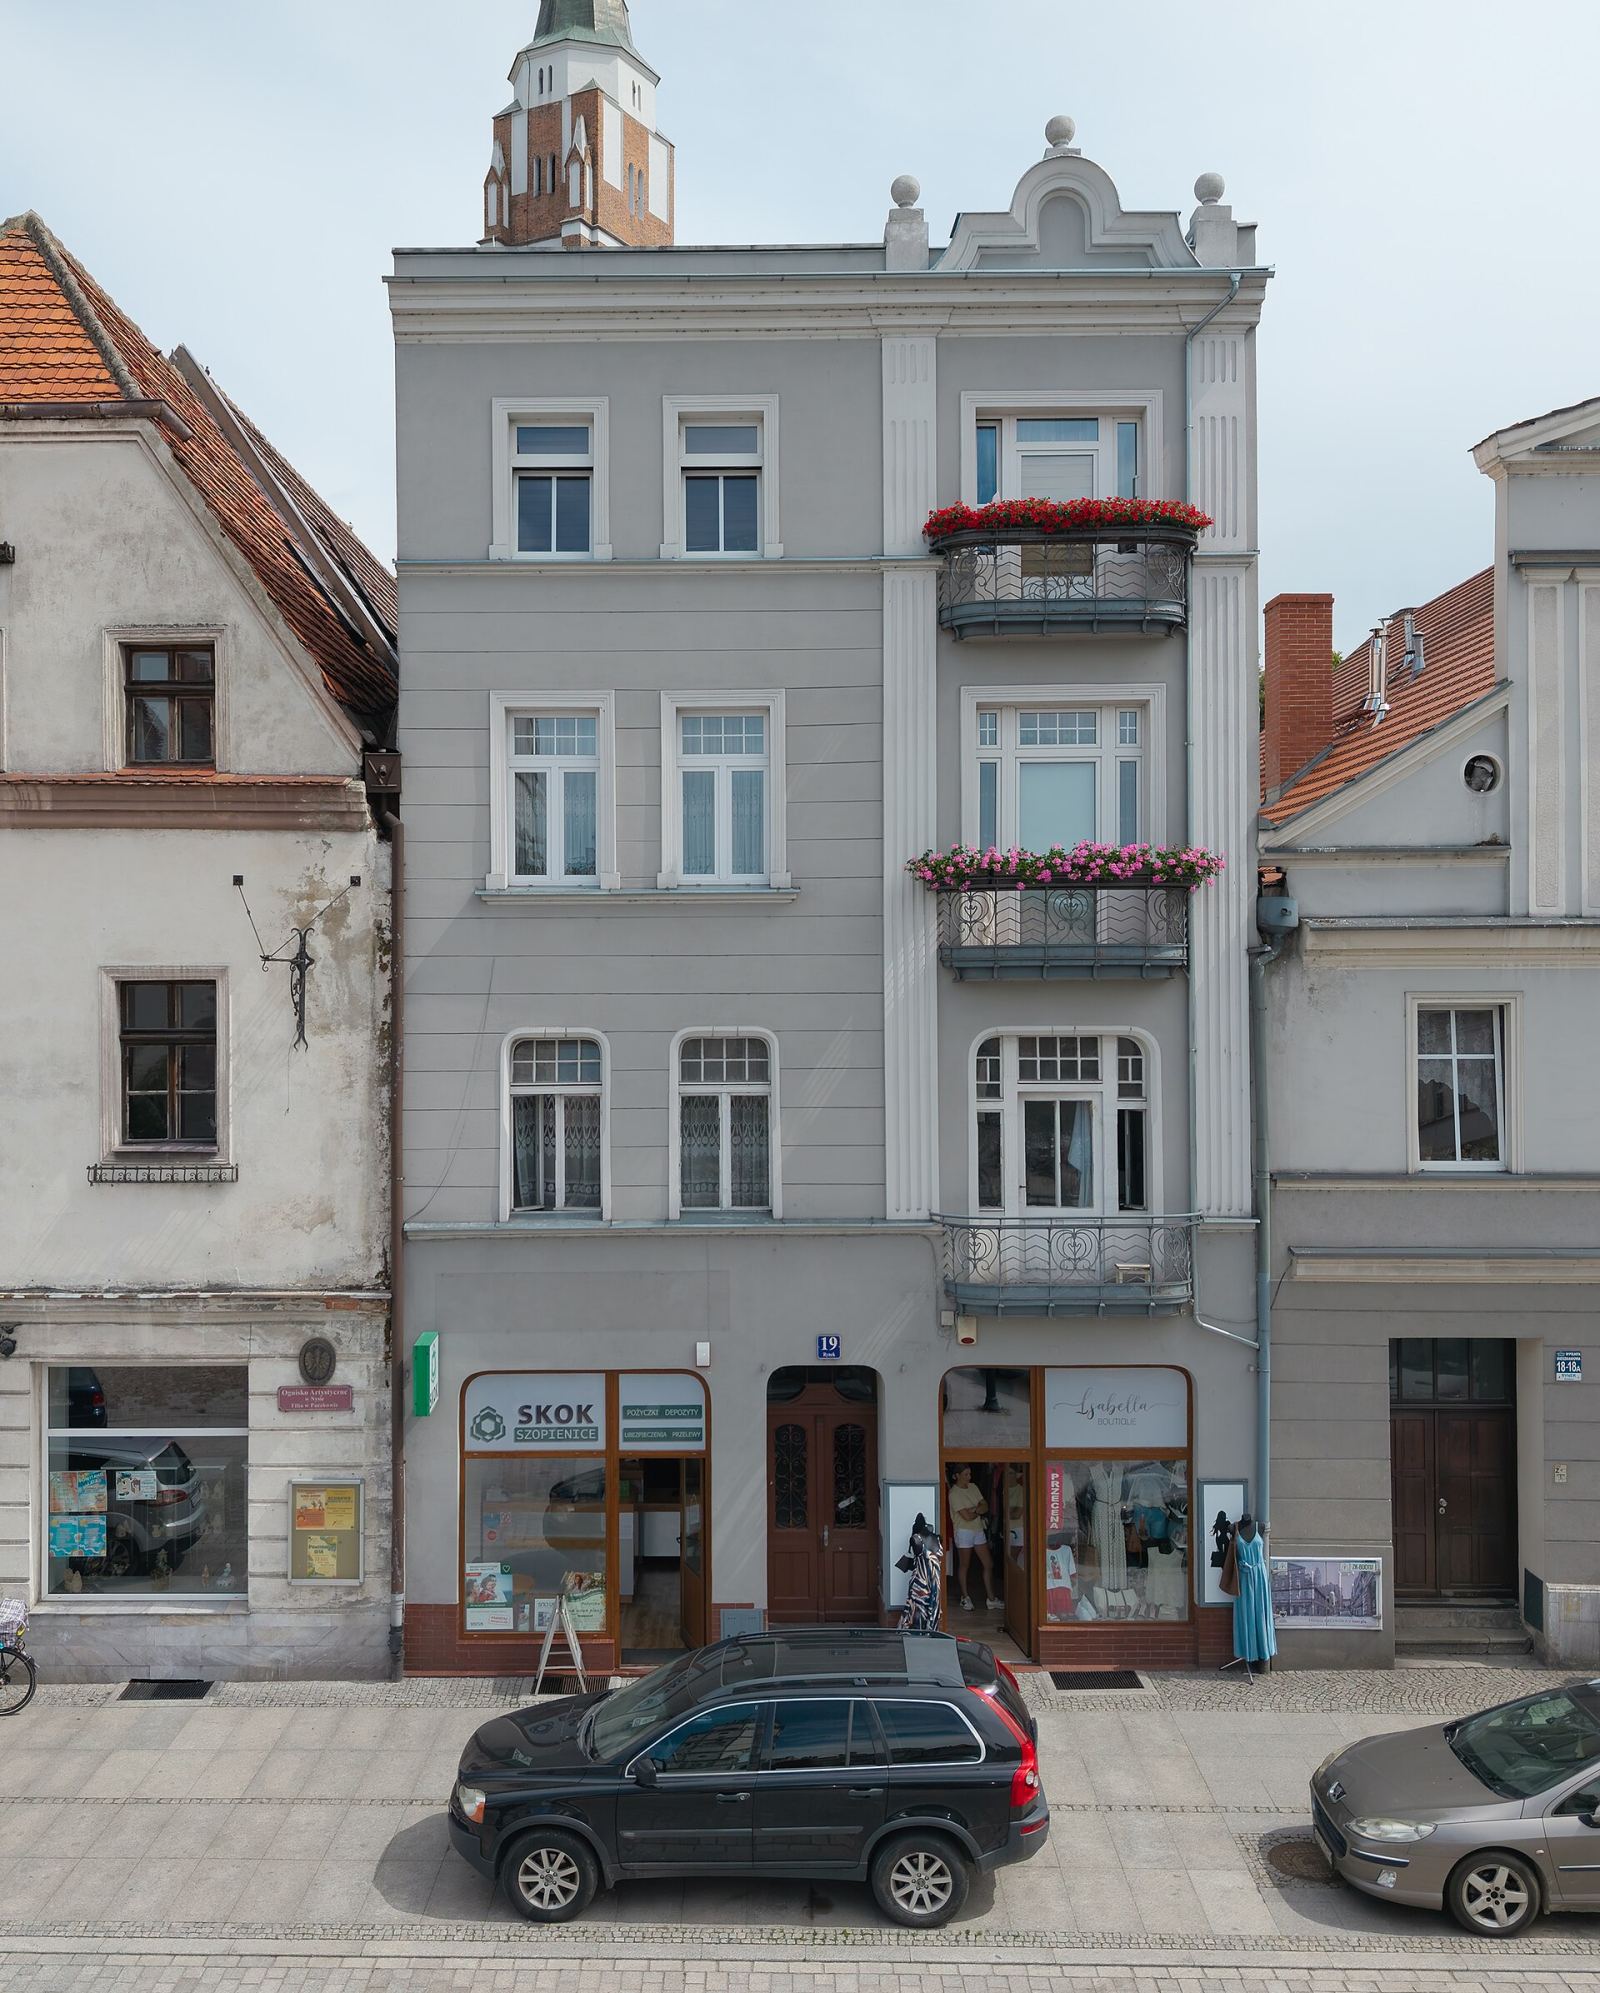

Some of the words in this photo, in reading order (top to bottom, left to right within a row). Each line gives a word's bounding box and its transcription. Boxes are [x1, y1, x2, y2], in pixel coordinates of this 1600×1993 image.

[820, 1336, 838, 1350] 19
[281, 1389, 309, 1397] Ognisko
[310, 1389, 348, 1397] Artystyczne
[1064, 1387, 1168, 1420] Isabella
[518, 1404, 594, 1425] SKOK
[626, 1407, 659, 1417] POŻYCZKI
[664, 1408, 699, 1416] DEPOZYTY
[1097, 1417, 1137, 1426] BOUTIQUE
[516, 1429, 596, 1440] SZOPIENICE
[1050, 1473, 1060, 1529] PRZECENA
